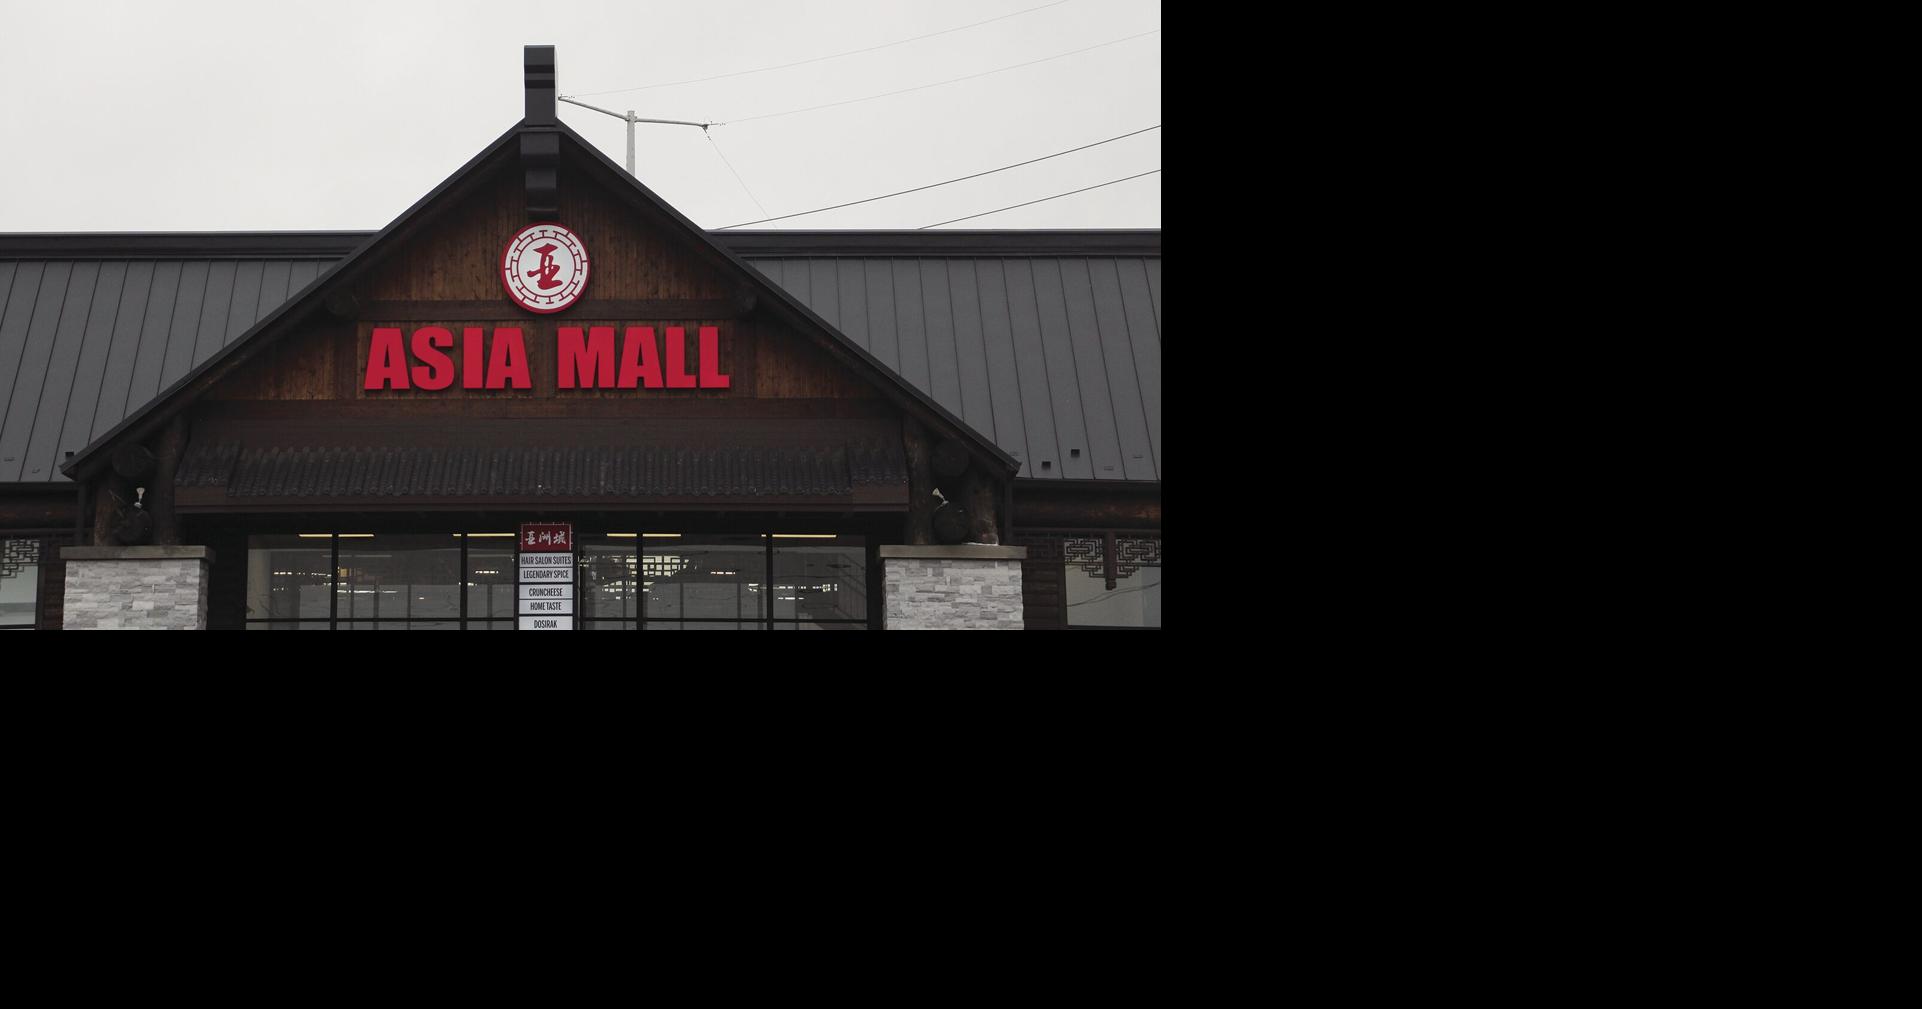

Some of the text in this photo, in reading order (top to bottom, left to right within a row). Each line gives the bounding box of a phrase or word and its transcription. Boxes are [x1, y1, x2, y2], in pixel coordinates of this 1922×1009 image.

[364, 326, 730, 390] ASIA MALL
[521, 556, 572, 565] HAIR SALON SUITES
[523, 570, 569, 579] LEGENDARY SPICE
[528, 588, 563, 597] CRUNCHEESE
[530, 602, 562, 611] HOME TASTE
[533, 620, 557, 629] DOSIRAK
